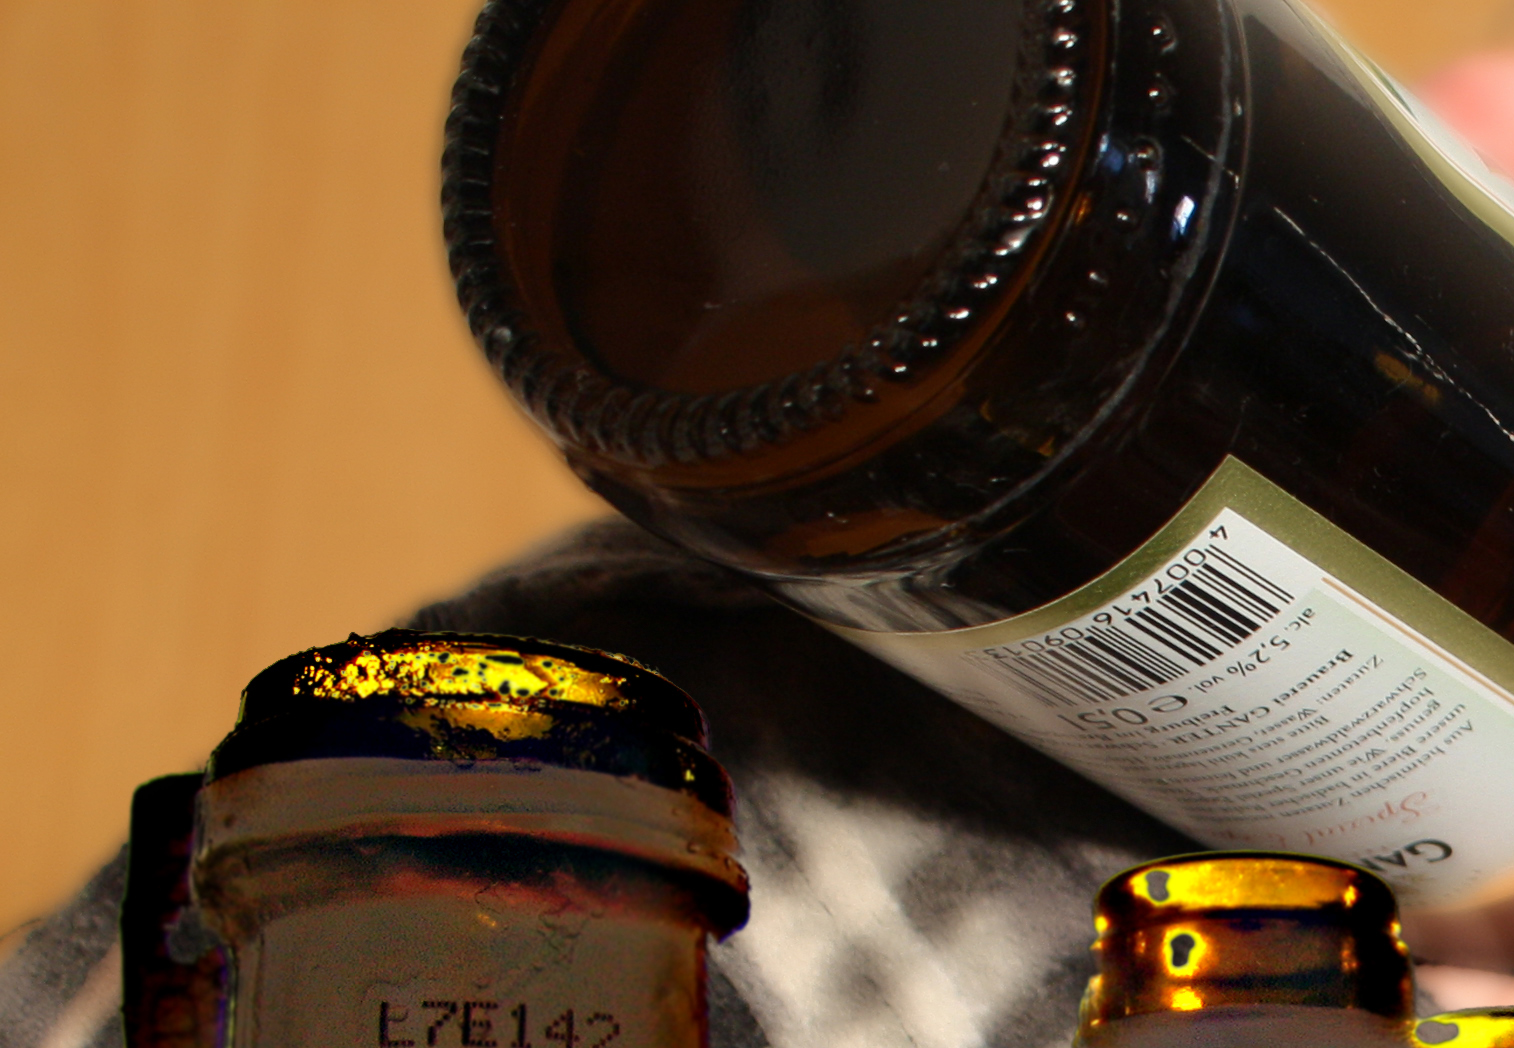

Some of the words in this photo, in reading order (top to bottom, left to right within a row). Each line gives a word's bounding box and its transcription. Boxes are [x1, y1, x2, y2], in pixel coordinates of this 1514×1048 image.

[1209, 523, 1228, 541] 4
[1091, 550, 1207, 625] 007416
[1282, 606, 1316, 633] alc.
[1225, 634, 1291, 678] 5,2%
[1186, 675, 1226, 694] vol.
[1271, 647, 1354, 707] Brauerei
[1314, 654, 1384, 707] Zutaten:
[1142, 704, 1236, 733] Freiburg
[1165, 707, 1271, 744] GANTER
[1252, 707, 1318, 738] Wasser,
[1275, 665, 1428, 764] Schwarzwaldwasser
[1286, 712, 1330, 739] Bitte
[1303, 685, 1435, 770] hopfenbetonten
[1383, 697, 1442, 745] genuss.
[1414, 702, 1467, 746] unsere
[1247, 736, 1286, 754] stets
[1442, 718, 1473, 748] Aus
[1235, 761, 1273, 778] und
[1346, 749, 1388, 769] Wie
[1349, 744, 1447, 798] heimischen
[1371, 743, 1418, 774] Biere
[1297, 764, 1346, 786] unser
[1348, 769, 1373, 784] in
